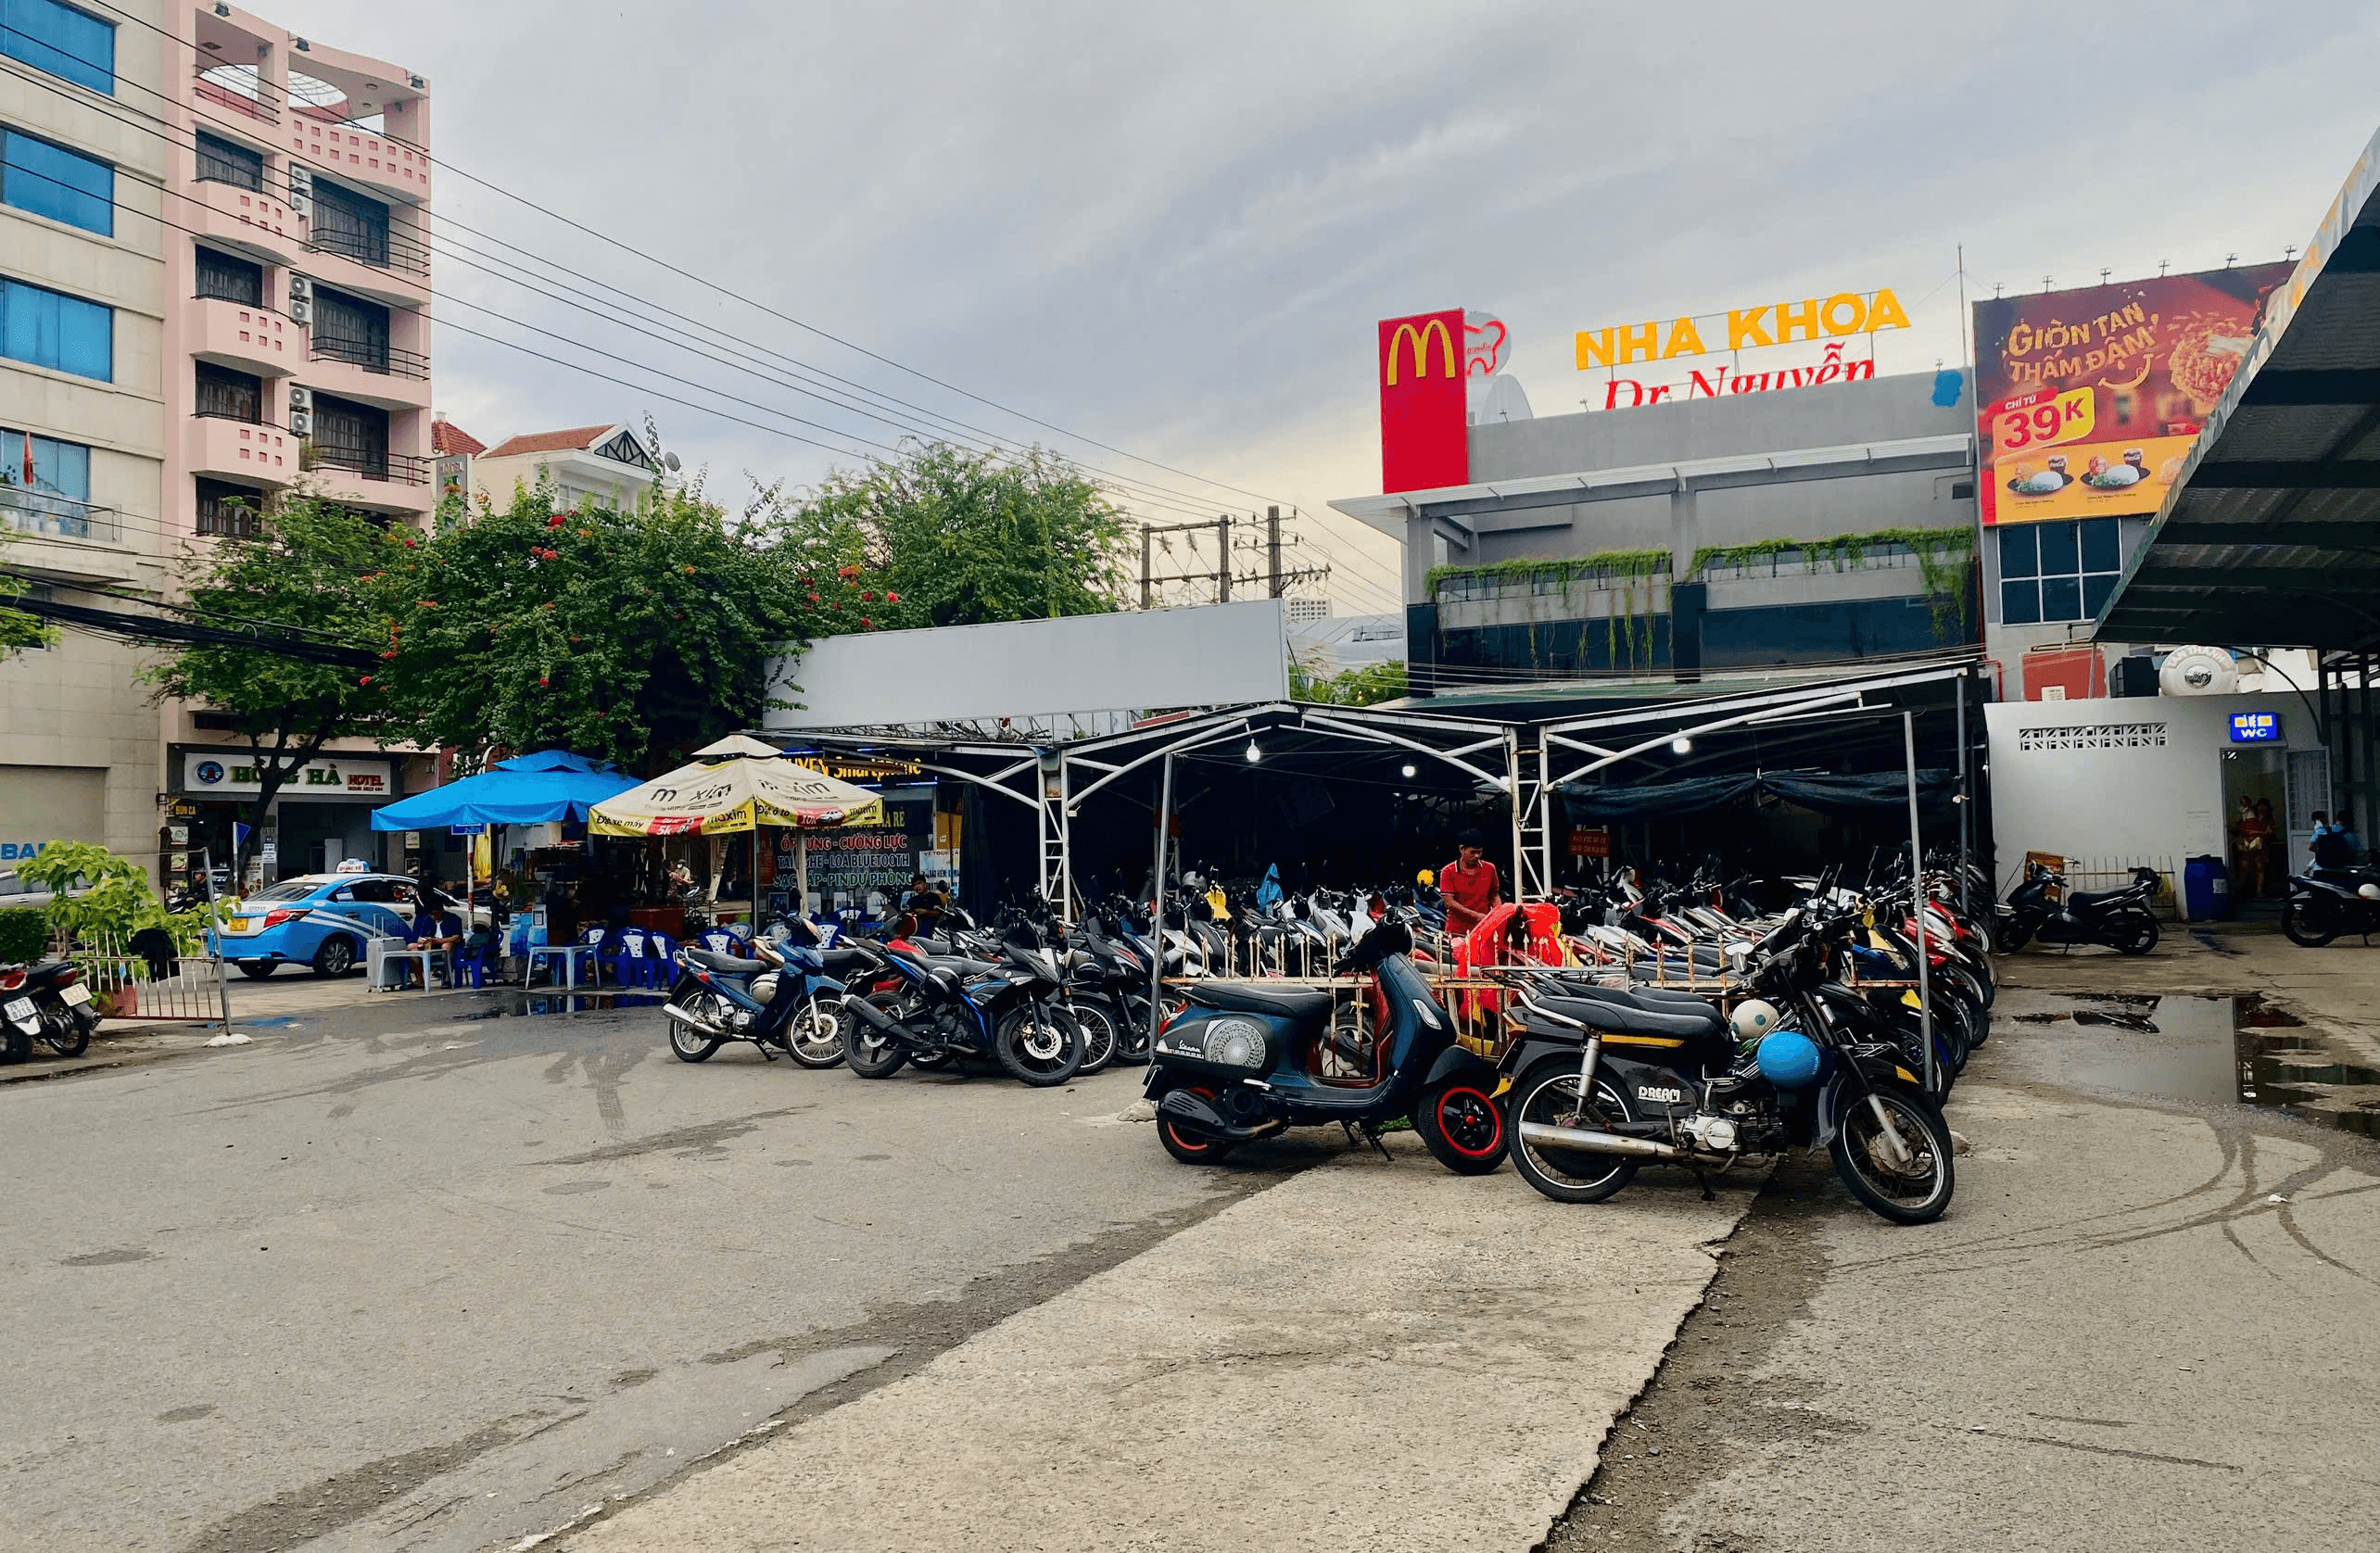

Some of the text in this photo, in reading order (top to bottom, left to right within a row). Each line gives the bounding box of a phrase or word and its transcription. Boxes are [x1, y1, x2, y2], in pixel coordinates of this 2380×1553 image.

[1576, 288, 1911, 370] NHA KHOA
[2085, 326, 2156, 371] ĐẬM
[2240, 727, 2268, 739] WC
[307, 763, 341, 785] HÀ
[348, 775, 385, 786] HOTEL
[805, 835, 832, 852] ƯNG
[839, 833, 882, 850] CƯỜNG
[883, 832, 908, 852] LỰC
[829, 854, 850, 868] LOA
[851, 853, 910, 867] BLUETOOTH
[806, 870, 823, 887] ÁP
[828, 873, 849, 887] PIN
[1638, 1085, 1681, 1103] DREAM
